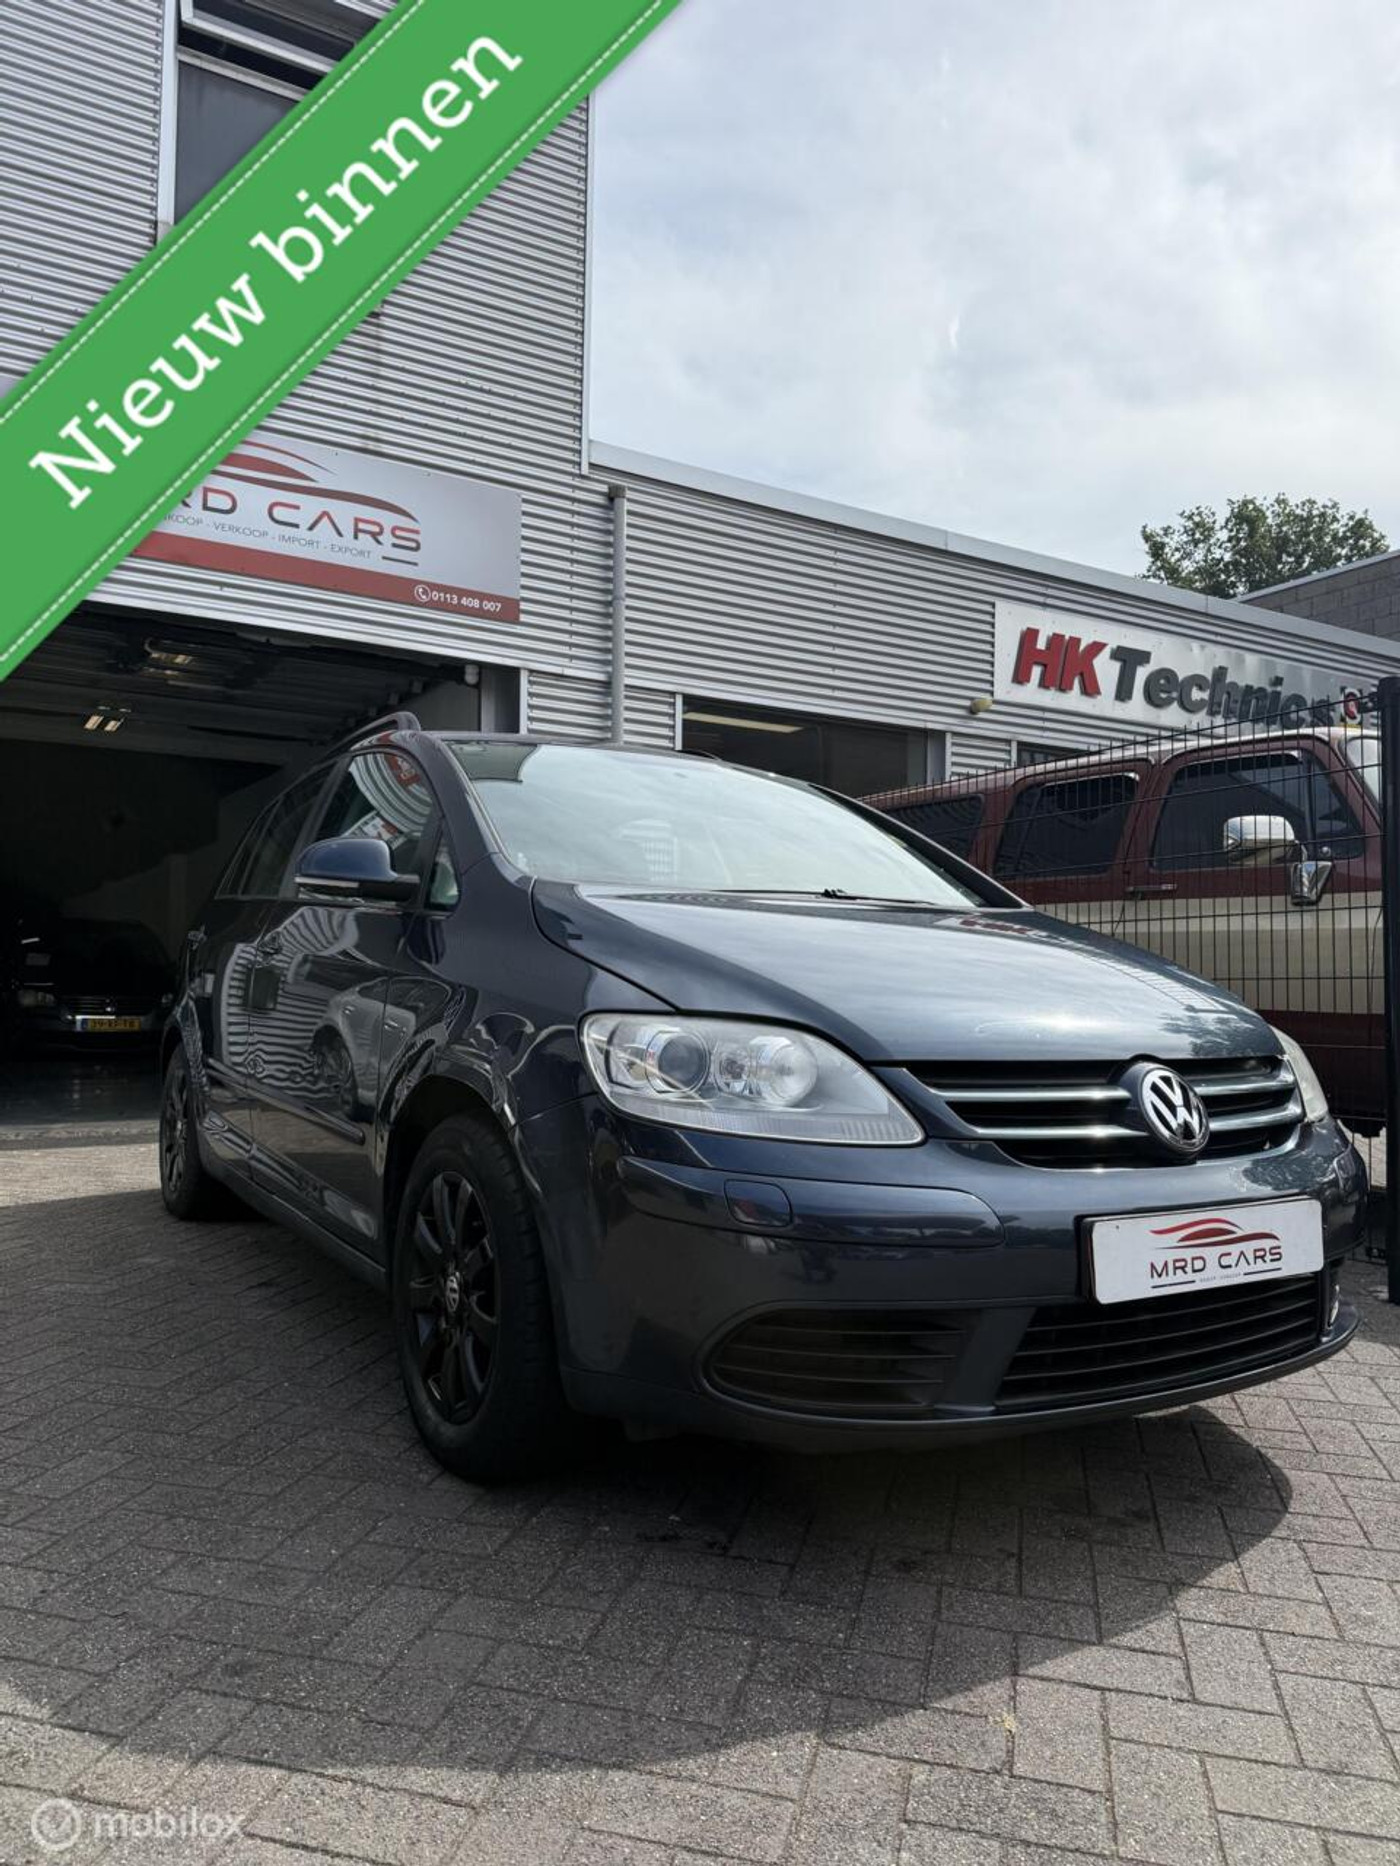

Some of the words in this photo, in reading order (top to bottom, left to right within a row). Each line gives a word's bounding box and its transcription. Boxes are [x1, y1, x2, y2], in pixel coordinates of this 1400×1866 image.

[213, 522, 269, 538] VERKOOP
[278, 534, 322, 550] IMPORT
[330, 543, 372, 559] EXPORT
[267, 501, 422, 553] CARS
[431, 590, 458, 604] 0113
[460, 596, 480, 609] 408
[482, 600, 502, 612] 007
[1149, 1255, 1207, 1279] MRD
[1217, 1245, 1284, 1270] CARS
